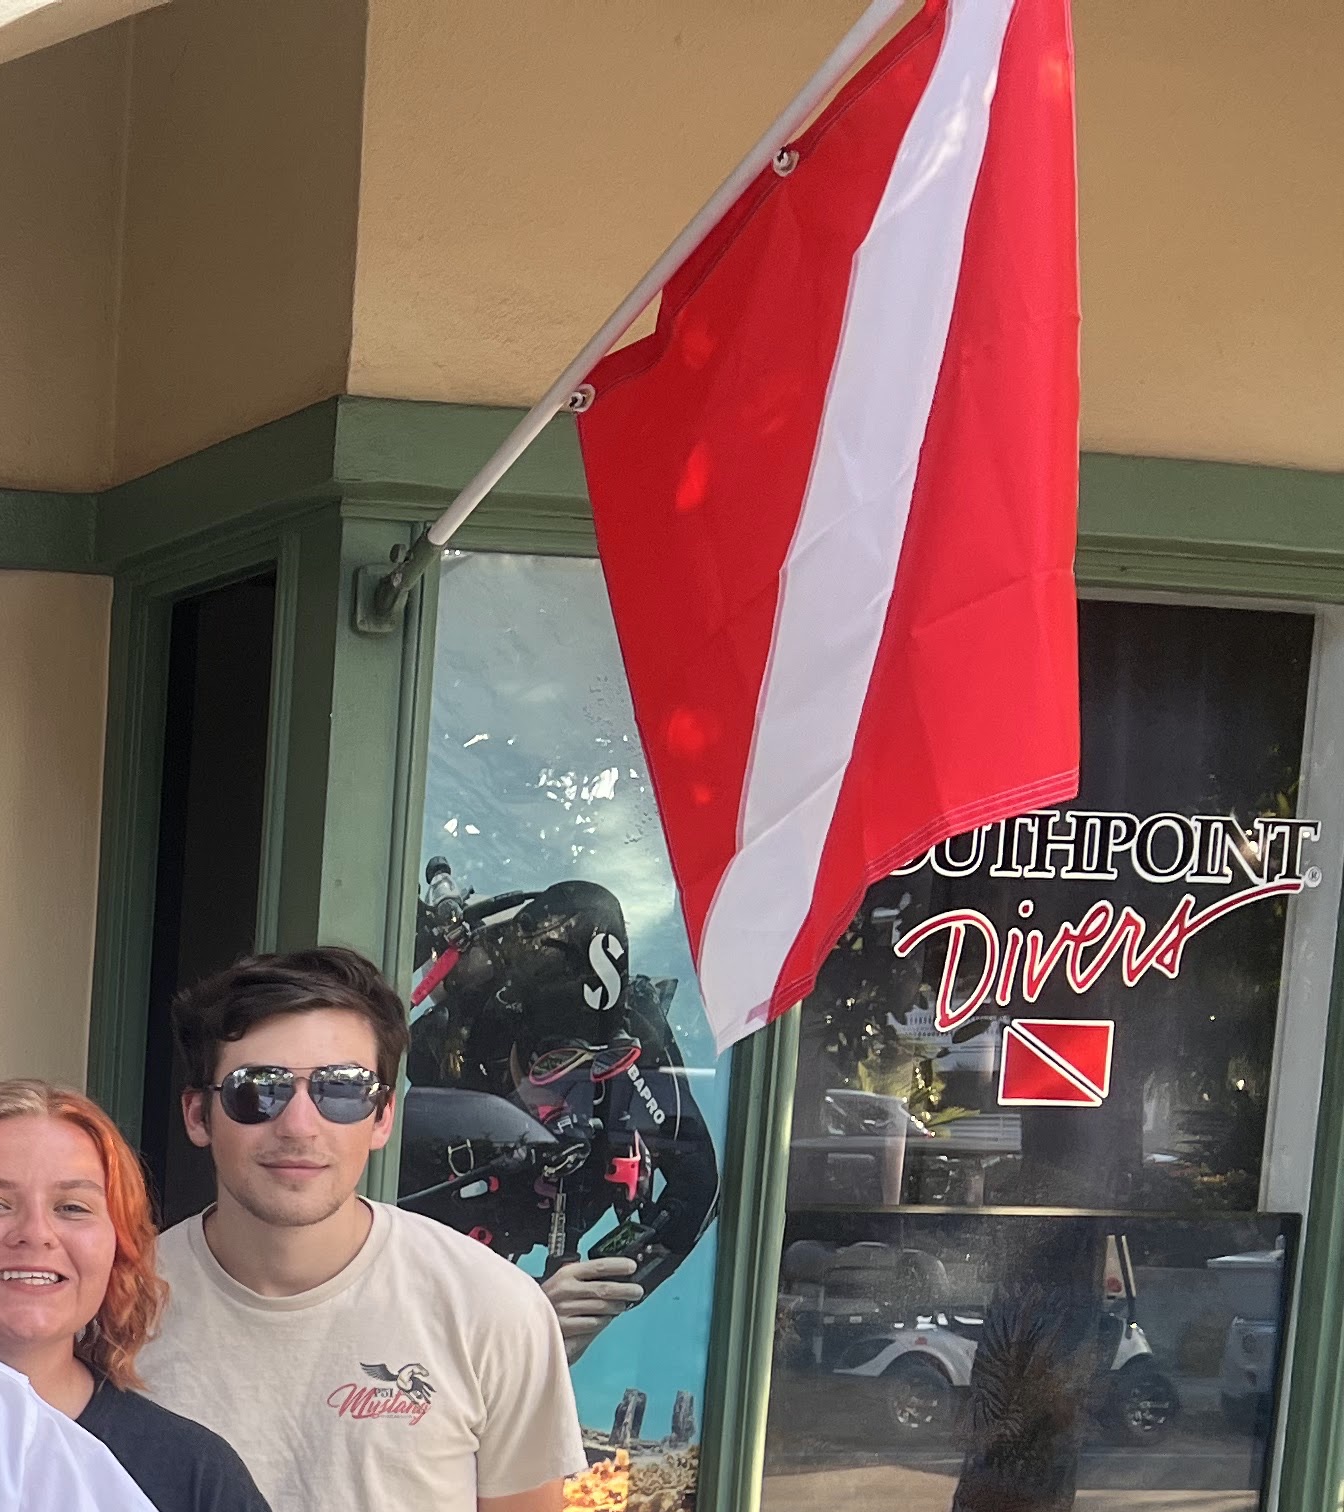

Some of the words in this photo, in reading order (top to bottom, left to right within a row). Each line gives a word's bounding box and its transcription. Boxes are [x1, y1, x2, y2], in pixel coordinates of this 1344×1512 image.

[889, 809, 1322, 885] UTHPOINT
[894, 879, 1303, 1033] Divers
[326, 1382, 432, 1426] Mustang
